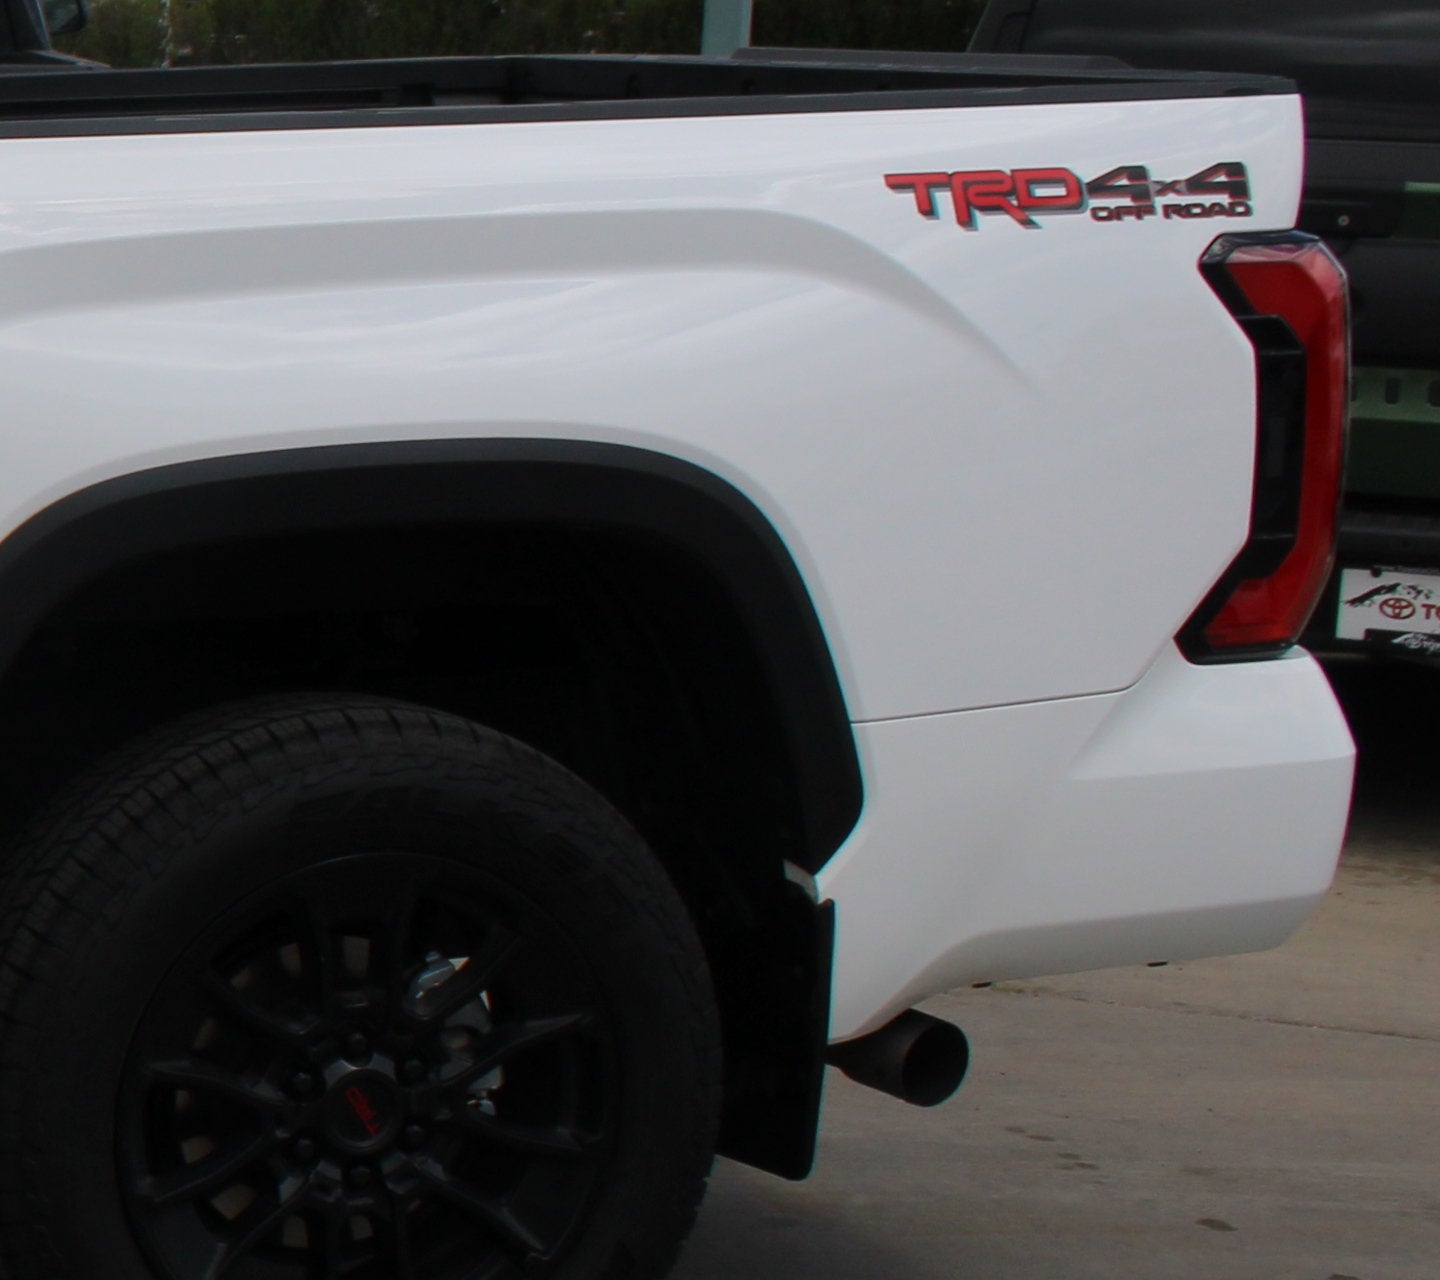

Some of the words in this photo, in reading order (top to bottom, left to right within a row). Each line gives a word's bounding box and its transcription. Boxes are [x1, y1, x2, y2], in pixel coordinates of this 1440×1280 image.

[883, 167, 1088, 231] TRD
[1090, 203, 1158, 222] OFF
[1163, 200, 1252, 220] ROAD
